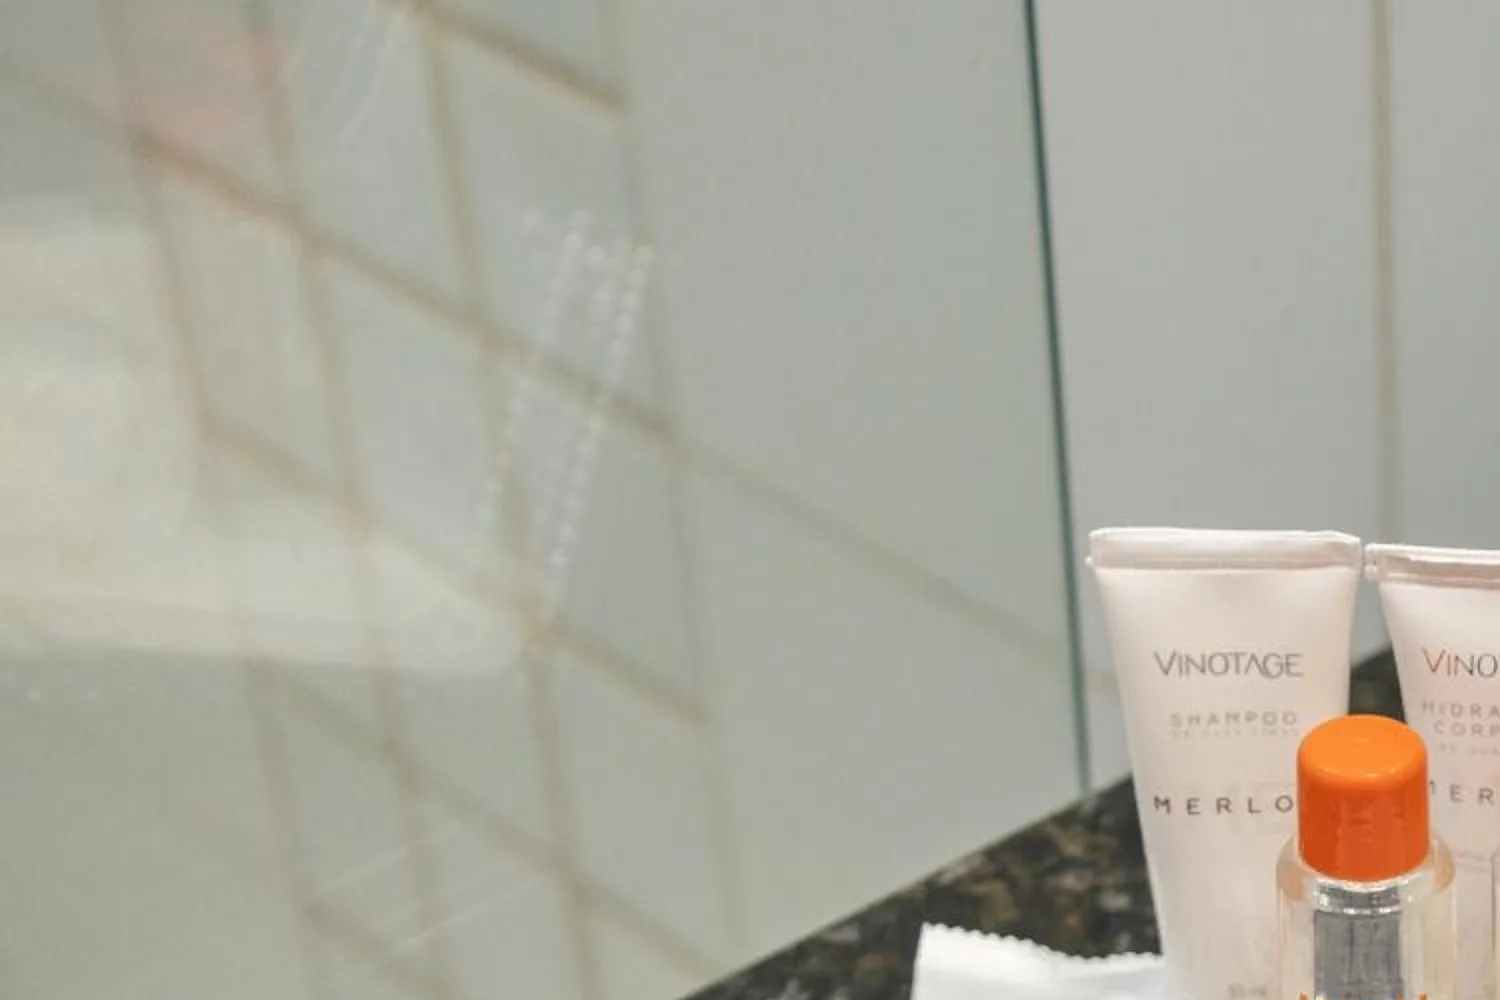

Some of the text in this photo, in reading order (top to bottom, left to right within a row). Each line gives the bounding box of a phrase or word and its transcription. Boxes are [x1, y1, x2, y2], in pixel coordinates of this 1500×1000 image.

[1153, 650, 1304, 679] VINOTAGE
[1169, 711, 1297, 728] SHAMPOO
[1153, 795, 1294, 815] MERLO
